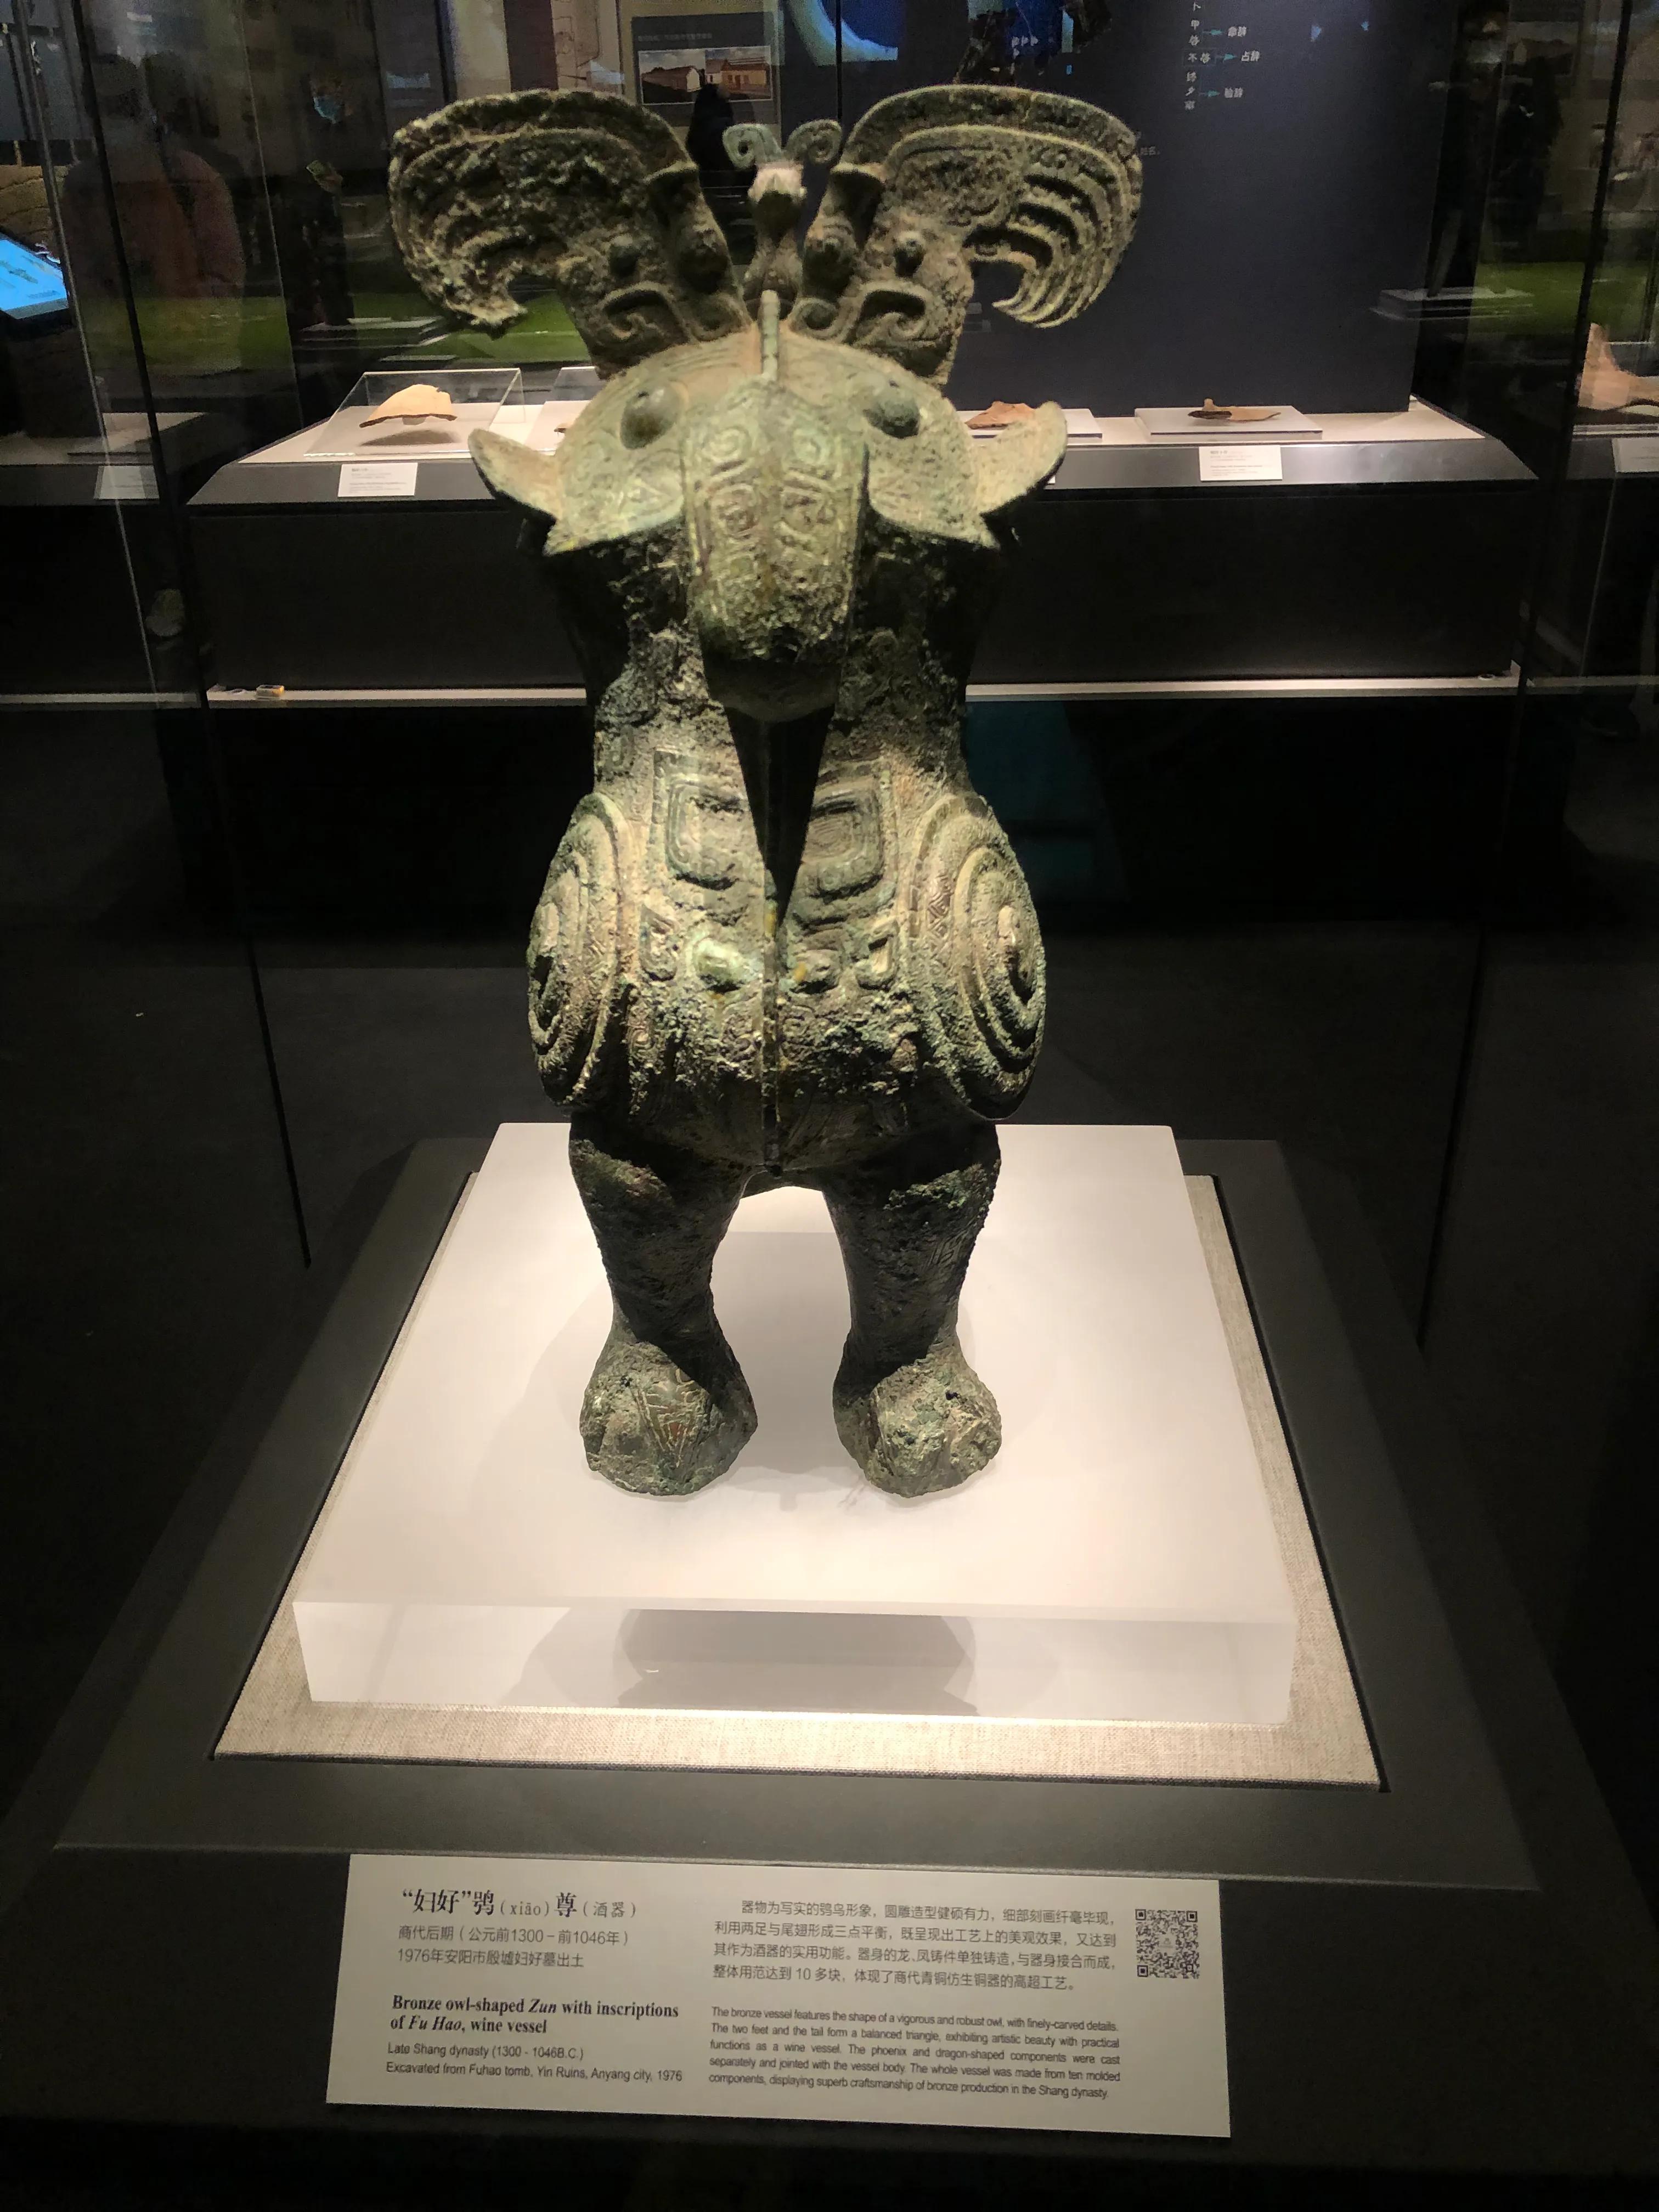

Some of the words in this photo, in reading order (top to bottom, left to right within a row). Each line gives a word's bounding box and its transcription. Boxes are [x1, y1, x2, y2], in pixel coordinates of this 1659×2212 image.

[398, 1948, 584, 1967] 1976年安阳市殷墟妇好墓出土
[392, 1995, 442, 2011] Bronze
[445, 1996, 524, 2016] owl-shaped
[528, 1999, 557, 2014] Zun
[562, 2000, 592, 2015] with
[597, 2000, 679, 2020] inscriptions
[712, 2006, 729, 2017] The
[731, 2007, 762, 2018] bronze
[763, 2009, 792, 2019] vessel
[794, 2009, 830, 2020] features
[832, 2011, 847, 2021] the
[848, 2012, 876, 2024] shape
[878, 2012, 888, 2022] of
[896, 2013, 935, 2025] vigorous
[936, 2015, 954, 2025] and
[956, 2016, 984, 2026] robust
[1007, 2018, 1025, 2028] with
[1026, 2018, 1084, 2030] finely-carved
[390, 2015, 406, 2030] of
[408, 2015, 428, 2030] Fu
[432, 2016, 466, 2034] Hao,
[471, 2017, 503, 2032] wine
[507, 2019, 547, 2033] vessel
[712, 2022, 729, 2033] The
[732, 2024, 748, 2034] two
[751, 2024, 769, 2035] feet
[772, 2025, 789, 2035] and
[793, 2025, 807, 2036] the
[811, 2027, 823, 2036] tail
[827, 2027, 848, 2037] form
[861, 2029, 902, 2040] balanced
[945, 2032, 988, 2045] exhibiting
[991, 2034, 1021, 2044] artistic
[1024, 2035, 1056, 2047] beauty
[1058, 2036, 1077, 2046] with
[1081, 2037, 1120, 2049] practical
[387, 2041, 410, 2054] Late
[413, 2042, 447, 2057] Shang
[449, 2044, 489, 2058] dynasty
[492, 2045, 522, 2058] (1300
[710, 2039, 751, 2051] functions
[784, 2042, 805, 2052] wine
[848, 2044, 866, 2055] The
[871, 2045, 907, 2057] phoenix
[912, 2047, 930, 2057] and
[935, 2048, 1005, 2061] dragon-shaped
[1011, 2051, 1066, 2063] components
[1073, 2055, 1096, 2064] were
[1101, 2055, 1120, 2064] cast
[386, 2061, 440, 2074] Excavated
[443, 2063, 466, 2075] from
[469, 2063, 501, 2076] Fuhao
[537, 2066, 552, 2076] Yin
[590, 2067, 630, 2082] Anyang
[658, 2069, 682, 2081] 1976
[709, 2057, 756, 2069] separately
[759, 2058, 776, 2068] and
[778, 2059, 809, 2070] jointed
[812, 2060, 830, 2069] with
[833, 2060, 848, 2070] the
[851, 2062, 879, 2072] vessel
[910, 2063, 928, 2073] The
[930, 2064, 958, 2075] whole
[961, 2066, 990, 2076] vessel
[993, 2069, 1012, 2077] was
[1015, 2068, 1042, 2078] made
[1045, 2068, 1065, 2079] from
[1068, 2070, 1083, 2080] ten
[1086, 2070, 1120, 2081] molded
[769, 2075, 814, 2089] displaying
[816, 2077, 848, 2089] superb
[850, 2078, 913, 2091] craftsmanship
[916, 2080, 926, 2090] of
[927, 2081, 959, 2092] bronze
[961, 2083, 1009, 2095] production
[1011, 2084, 1020, 2094] in
[1022, 2084, 1036, 2095] the
[1039, 2085, 1069, 2098] Shang
